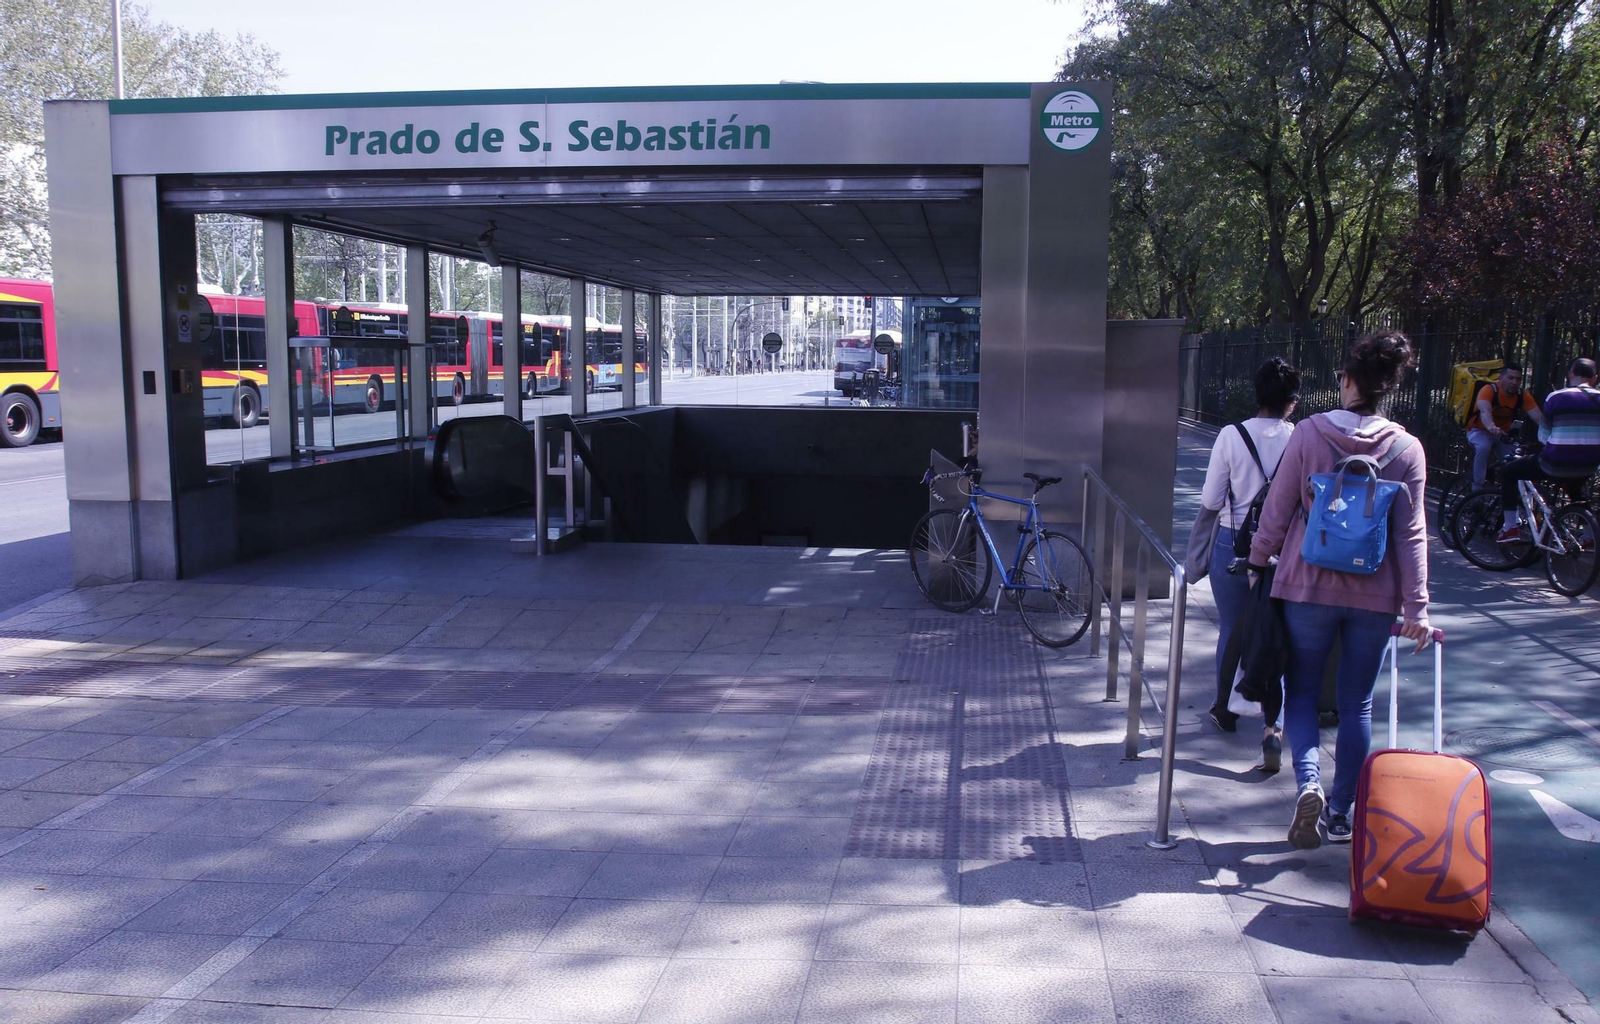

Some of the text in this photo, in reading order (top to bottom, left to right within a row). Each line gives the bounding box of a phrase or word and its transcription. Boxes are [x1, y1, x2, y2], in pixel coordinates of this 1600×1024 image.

[1050, 114, 1093, 126] Metro
[325, 113, 771, 156] Prado de S. Sebastián
